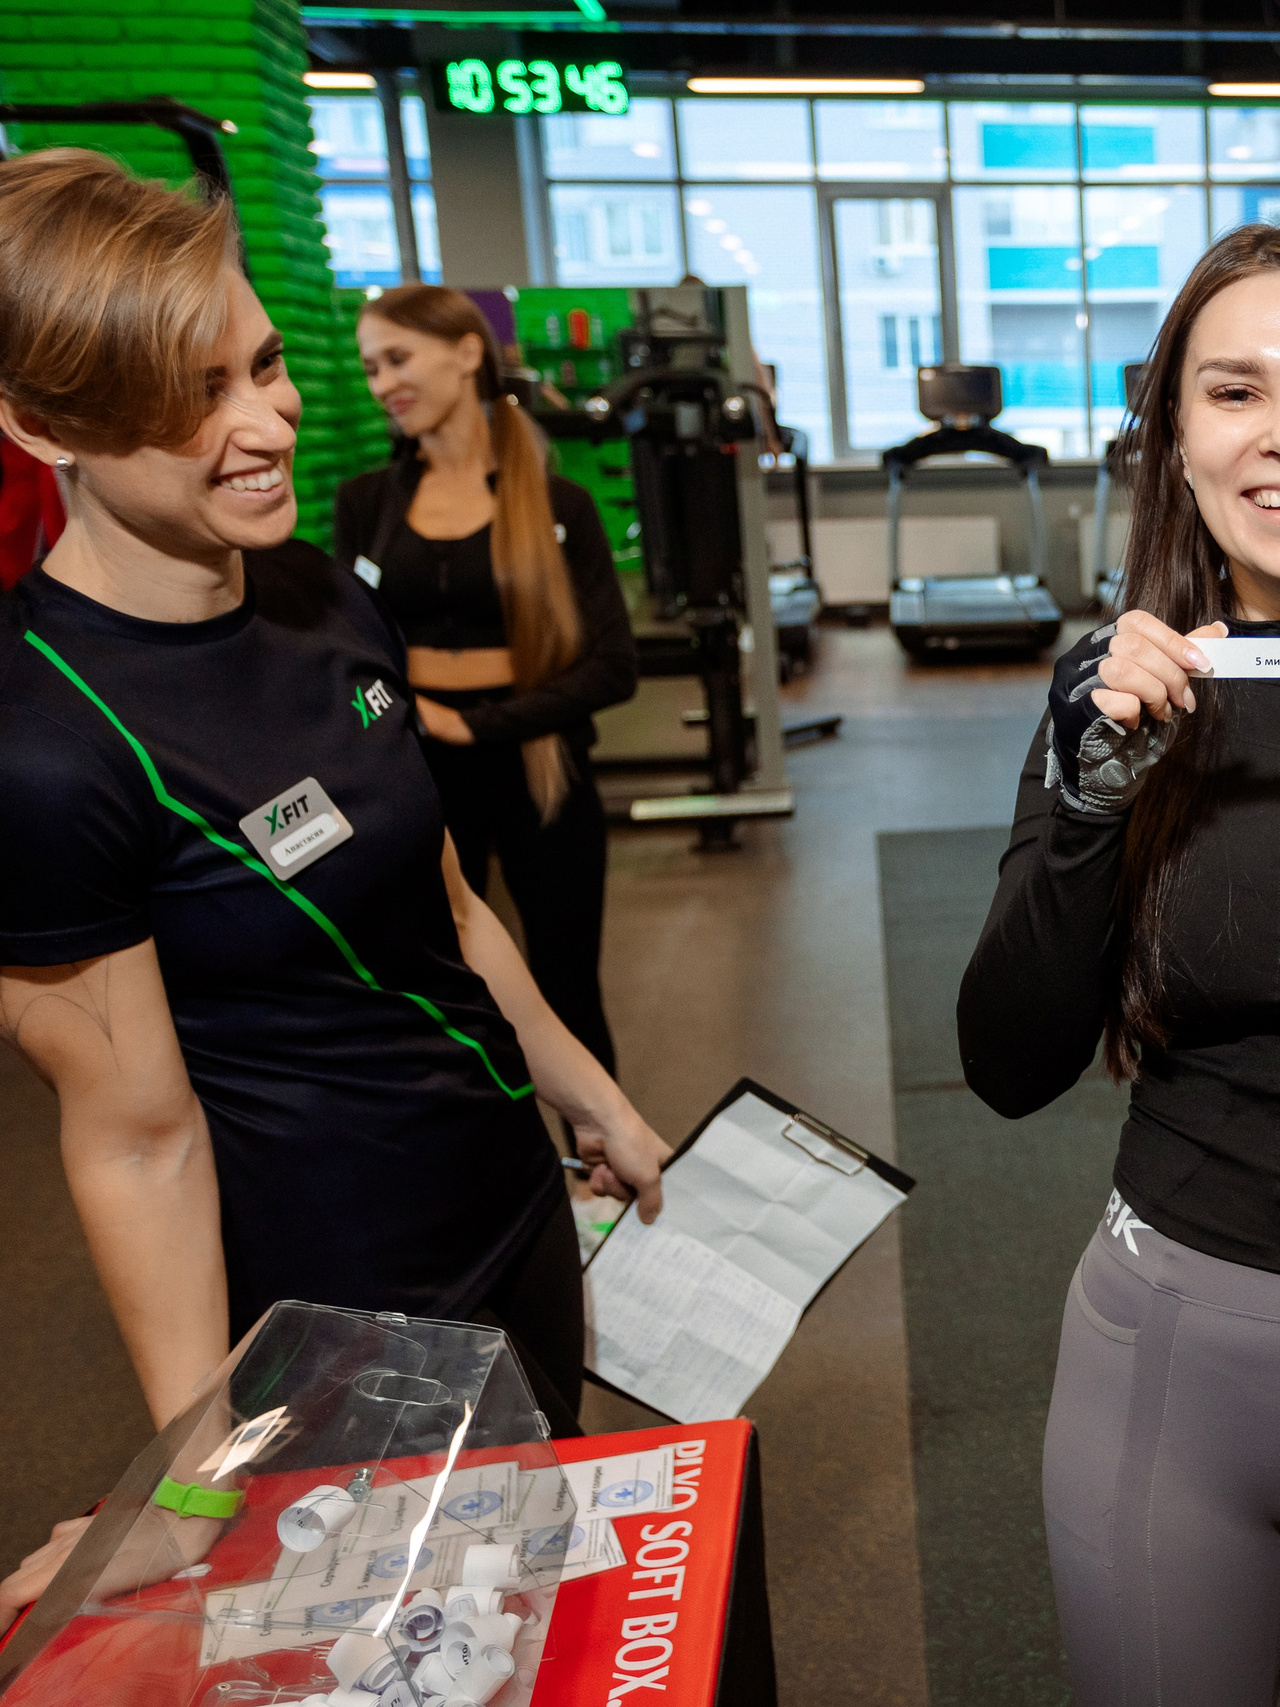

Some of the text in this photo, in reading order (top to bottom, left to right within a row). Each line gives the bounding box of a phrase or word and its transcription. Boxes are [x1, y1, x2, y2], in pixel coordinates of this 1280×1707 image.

[446, 58, 629, 114] 10 53 46
[1255, 657, 1262, 666] 5
[351, 679, 394, 729] XFIT
[264, 794, 310, 837] XFIT
[627, 1520, 693, 1601] SOFT
